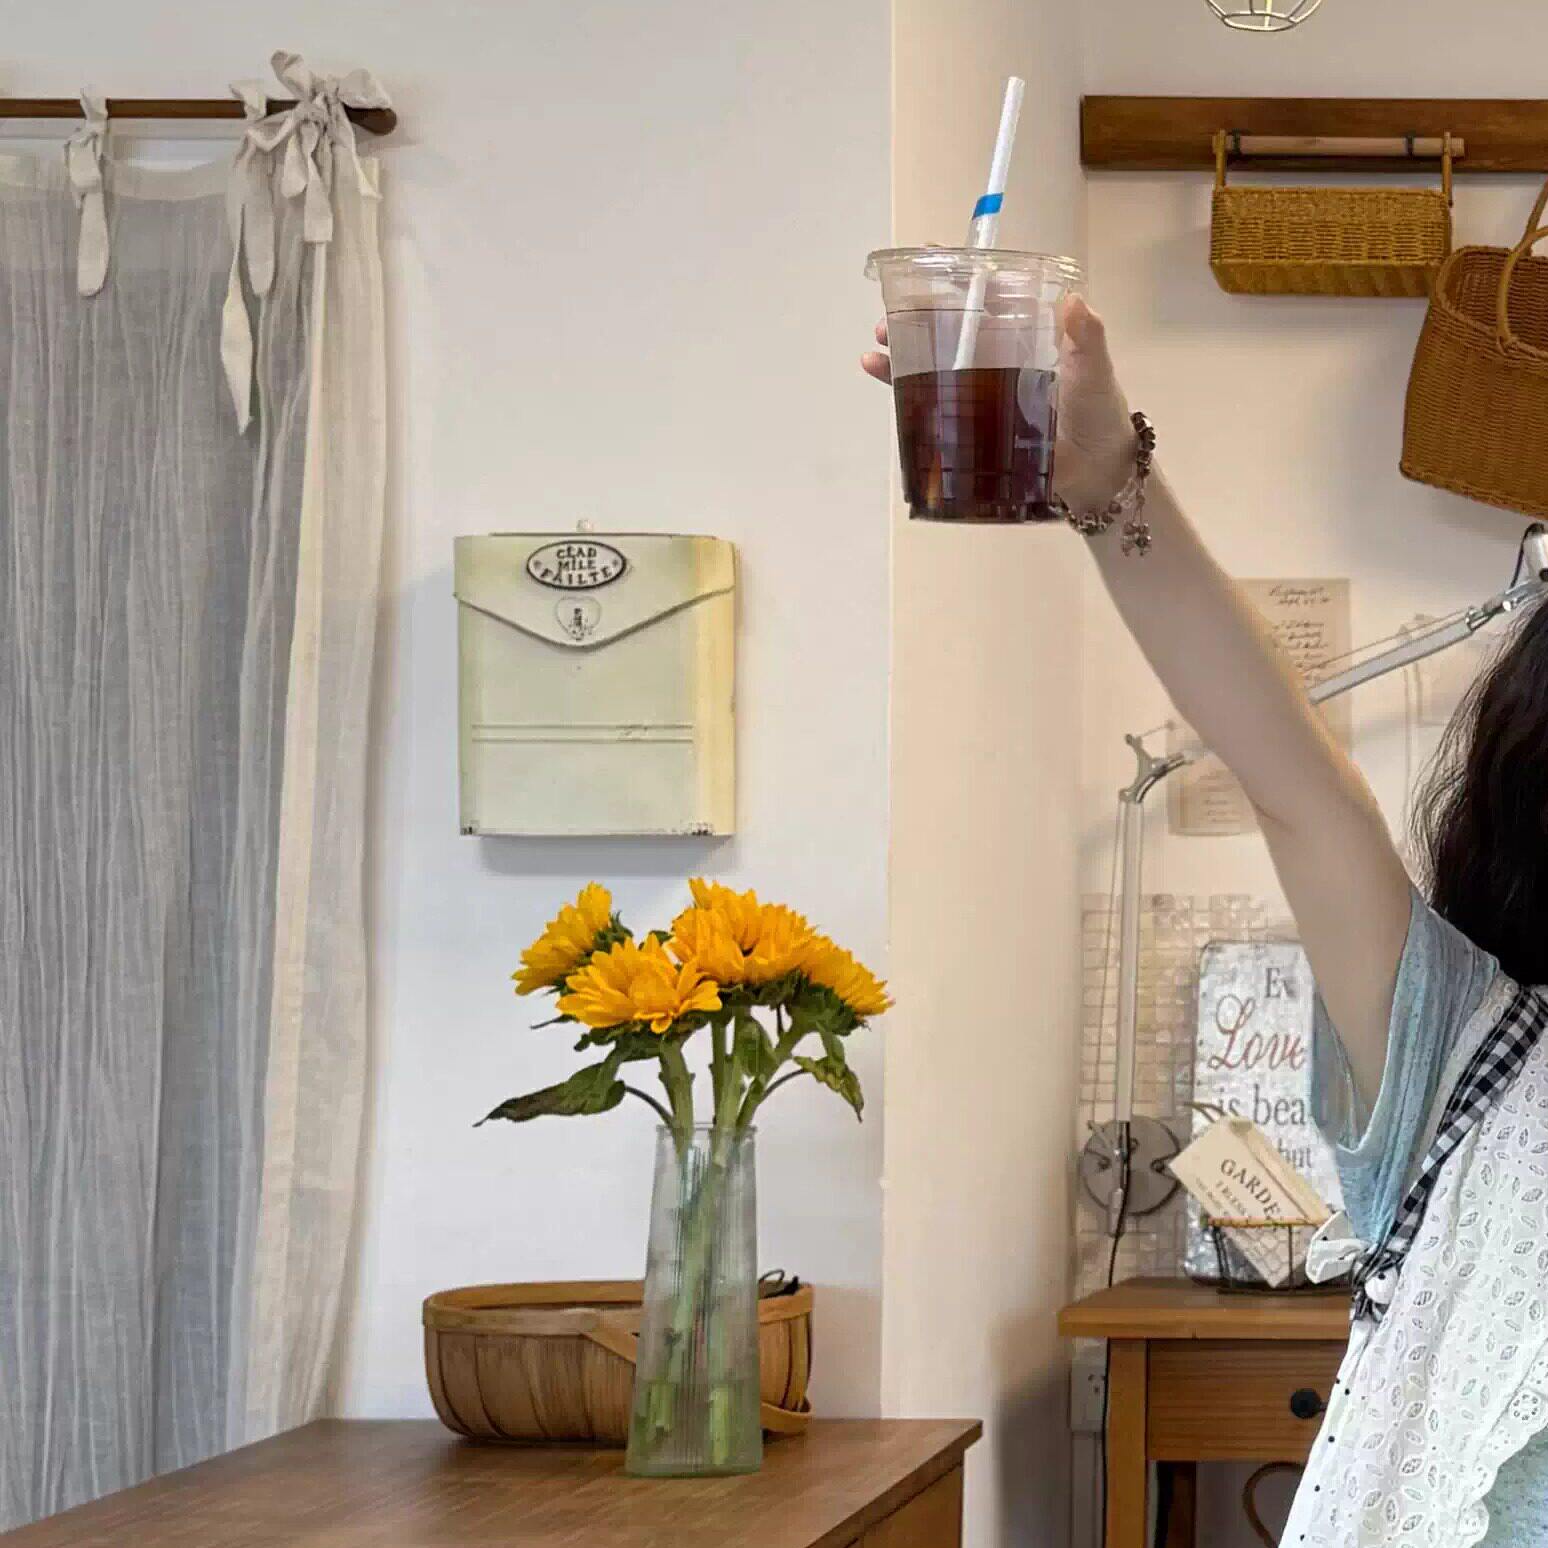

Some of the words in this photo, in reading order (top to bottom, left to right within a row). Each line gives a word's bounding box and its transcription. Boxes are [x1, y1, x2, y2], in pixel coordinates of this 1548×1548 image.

[1207, 993, 1305, 1071] Love
[1253, 1083, 1305, 1125] bea
[1220, 1158, 1281, 1220] GARDE
